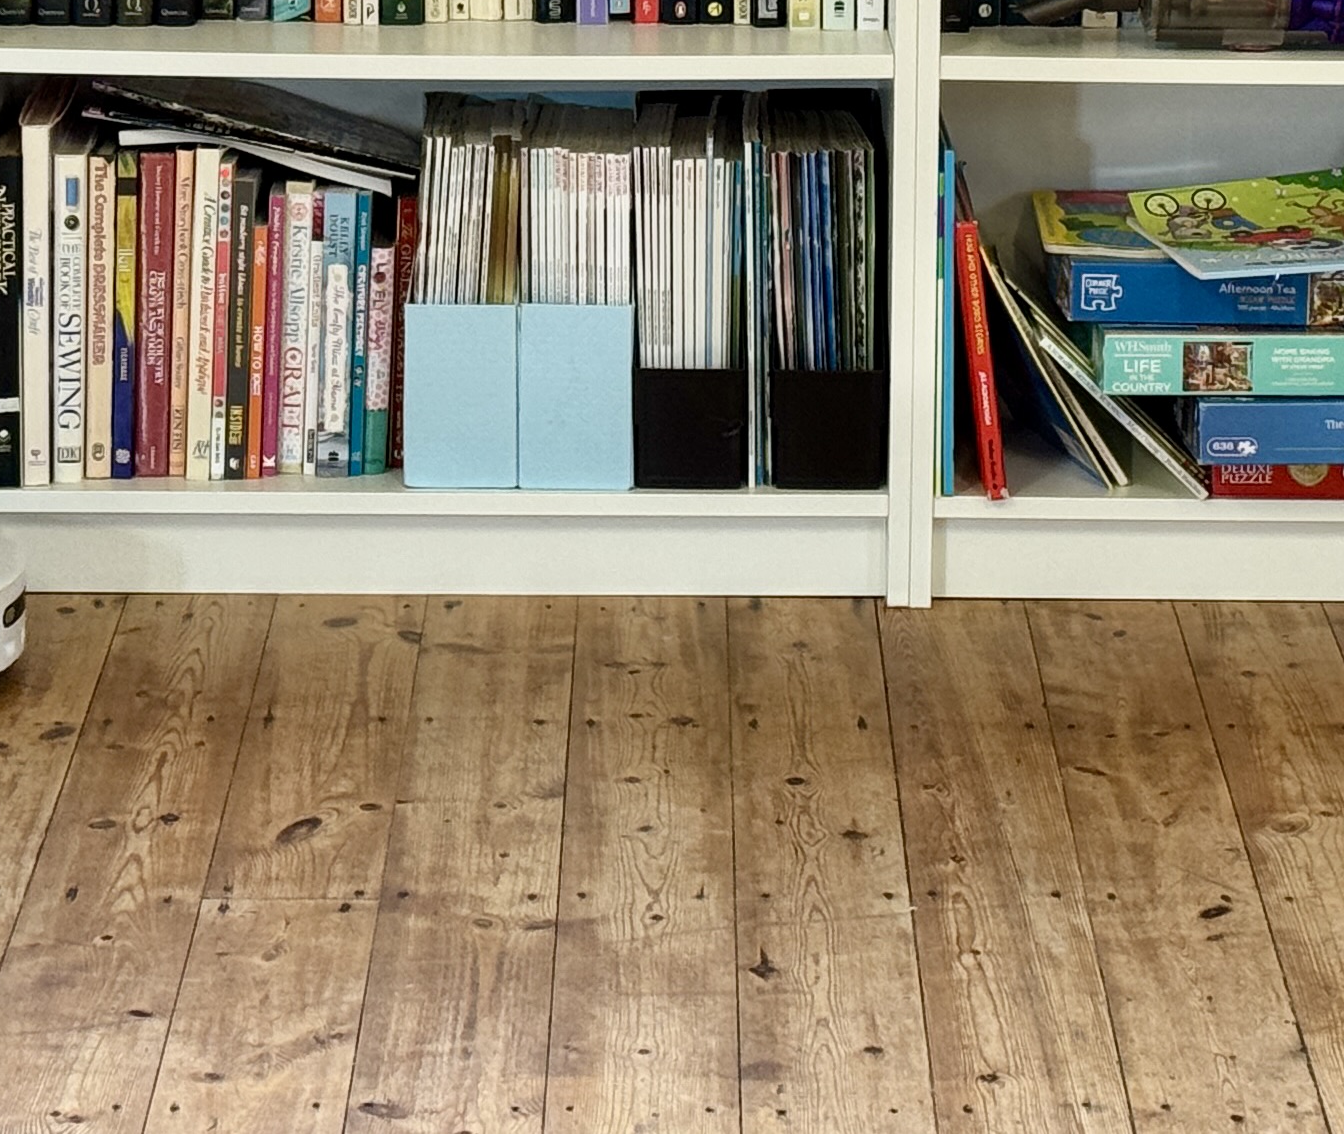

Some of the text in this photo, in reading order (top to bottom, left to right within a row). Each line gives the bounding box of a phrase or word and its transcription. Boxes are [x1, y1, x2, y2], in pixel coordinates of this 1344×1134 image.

[0, 203, 16, 280] PRACTICAL
[57, 312, 82, 429] SEWING
[1124, 359, 1162, 373] LIFE
